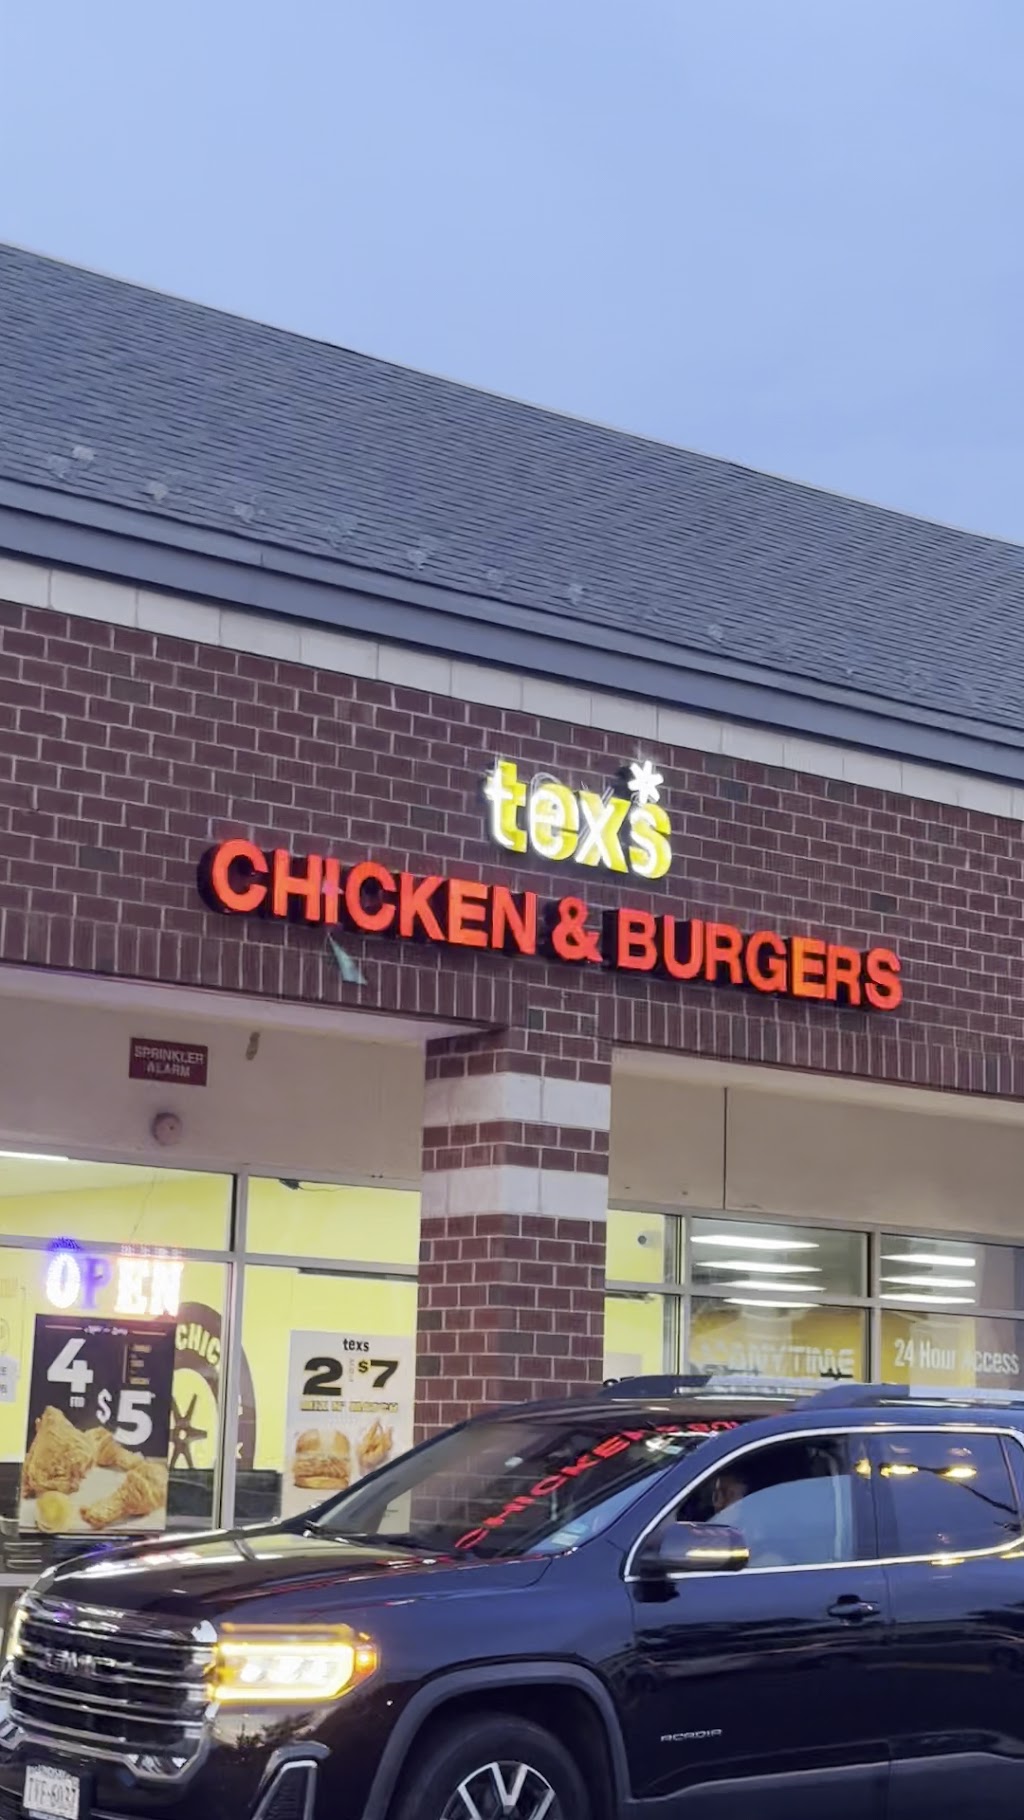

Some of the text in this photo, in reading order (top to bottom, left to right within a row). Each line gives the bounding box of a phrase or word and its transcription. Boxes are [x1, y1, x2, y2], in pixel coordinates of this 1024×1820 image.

[211, 838, 903, 1010] CHICKEN & BURGERS
[134, 1045, 204, 1065] SPRINKLER
[147, 1061, 190, 1077] ALARM
[46, 1252, 186, 1317] OPEN
[342, 1338, 370, 1352] texs
[894, 1338, 914, 1368] 24
[920, 1339, 957, 1370] Hour
[47, 1338, 94, 1393] 4
[302, 1357, 343, 1396] 2
[358, 1359, 399, 1388] $7
[96, 1388, 156, 1446] $5
[660, 1729, 722, 1742] ACADIA
